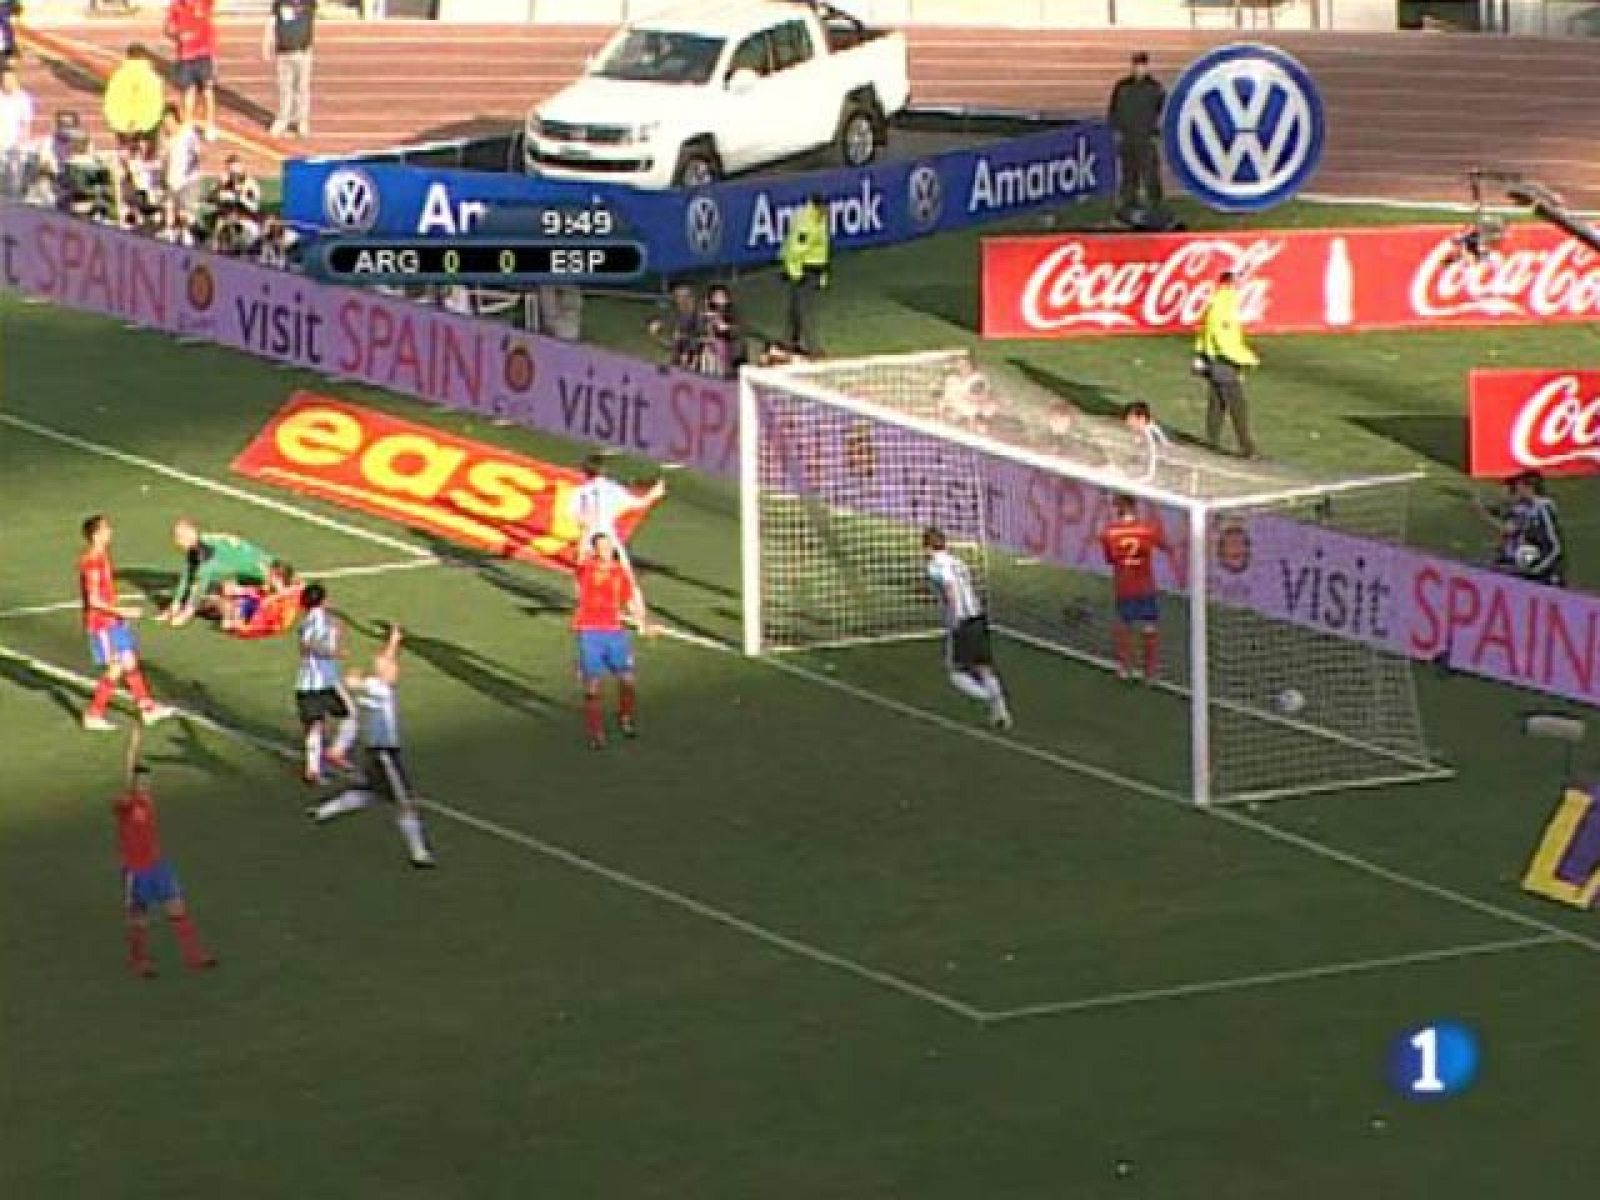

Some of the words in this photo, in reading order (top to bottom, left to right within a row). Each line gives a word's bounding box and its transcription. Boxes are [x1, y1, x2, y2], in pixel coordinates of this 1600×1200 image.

[968, 135, 1096, 213] Amarok
[34, 219, 168, 322] SPAIN
[234, 282, 322, 365] visit
[338, 298, 482, 407] SPAIN
[559, 366, 650, 449] visit
[1118, 536, 1141, 566] 2
[1278, 547, 1392, 637] visit
[1411, 566, 1600, 694] SPAIN
